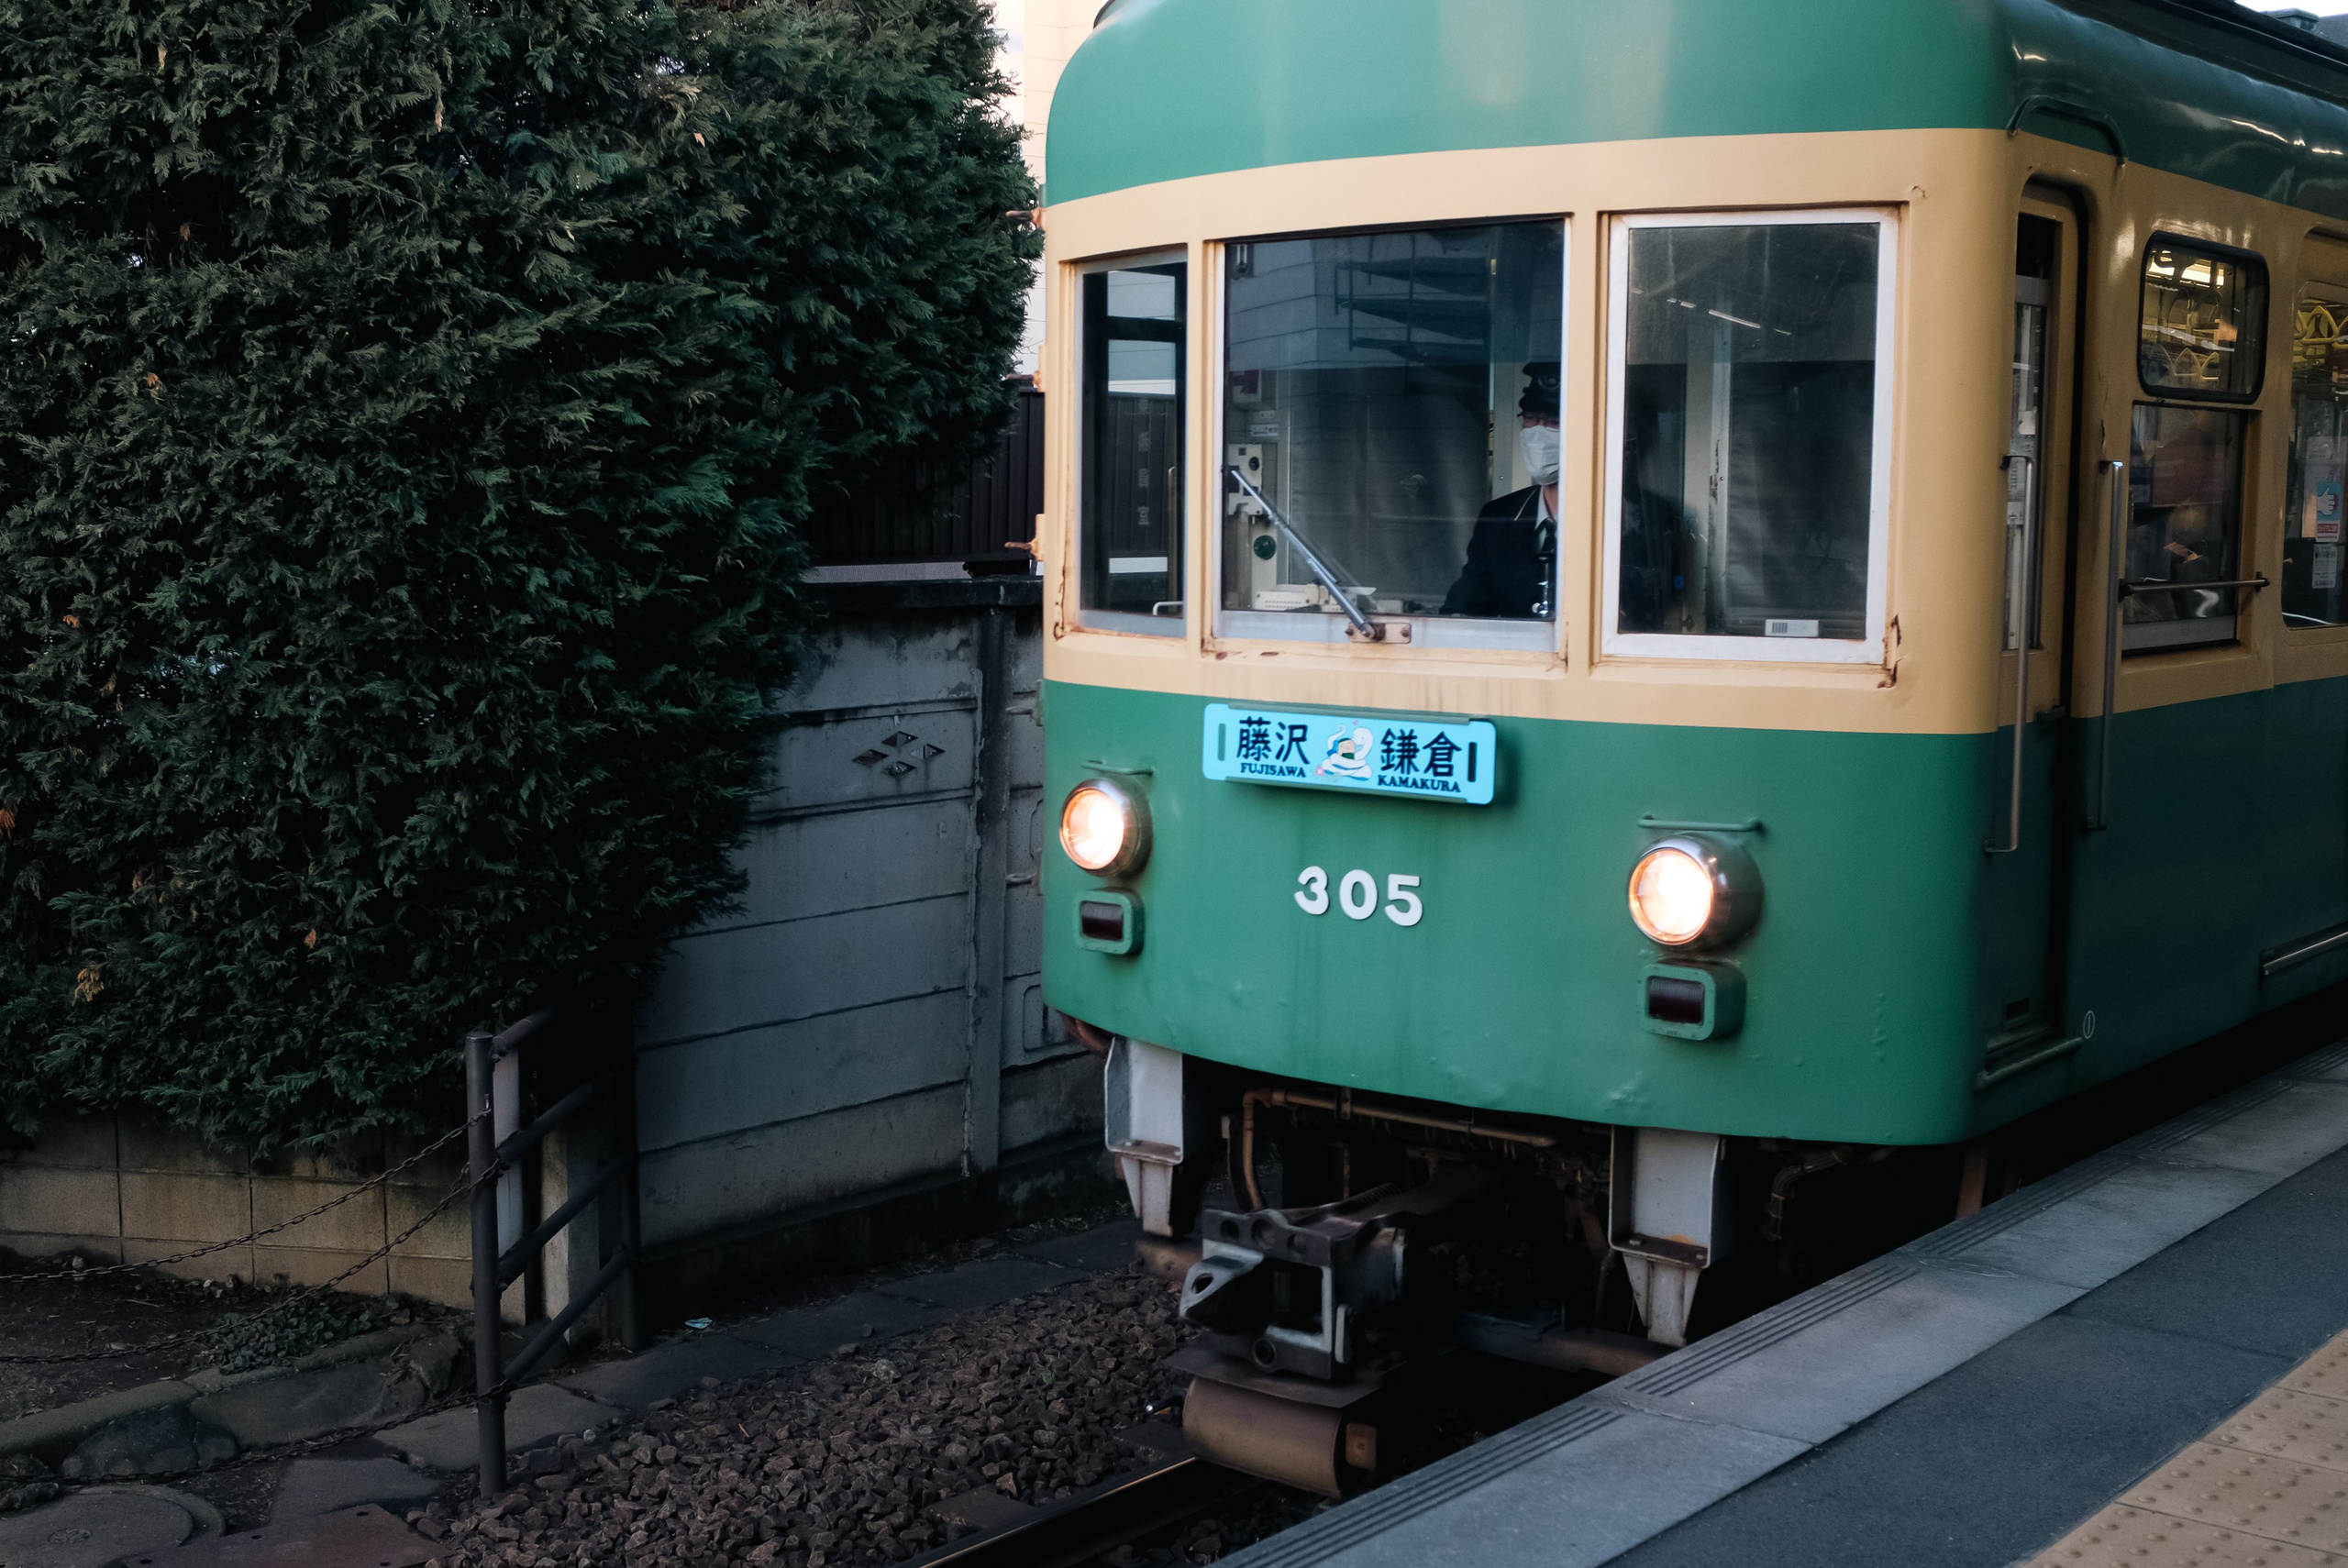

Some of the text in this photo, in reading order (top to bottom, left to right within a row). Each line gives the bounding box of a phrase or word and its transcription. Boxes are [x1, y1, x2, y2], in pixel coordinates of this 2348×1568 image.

[1237, 716, 1463, 778] 藤沢 鎌倉
[1240, 762, 1461, 793] FUJISAWA KAMAKURA
[1294, 866, 1423, 927] 305
